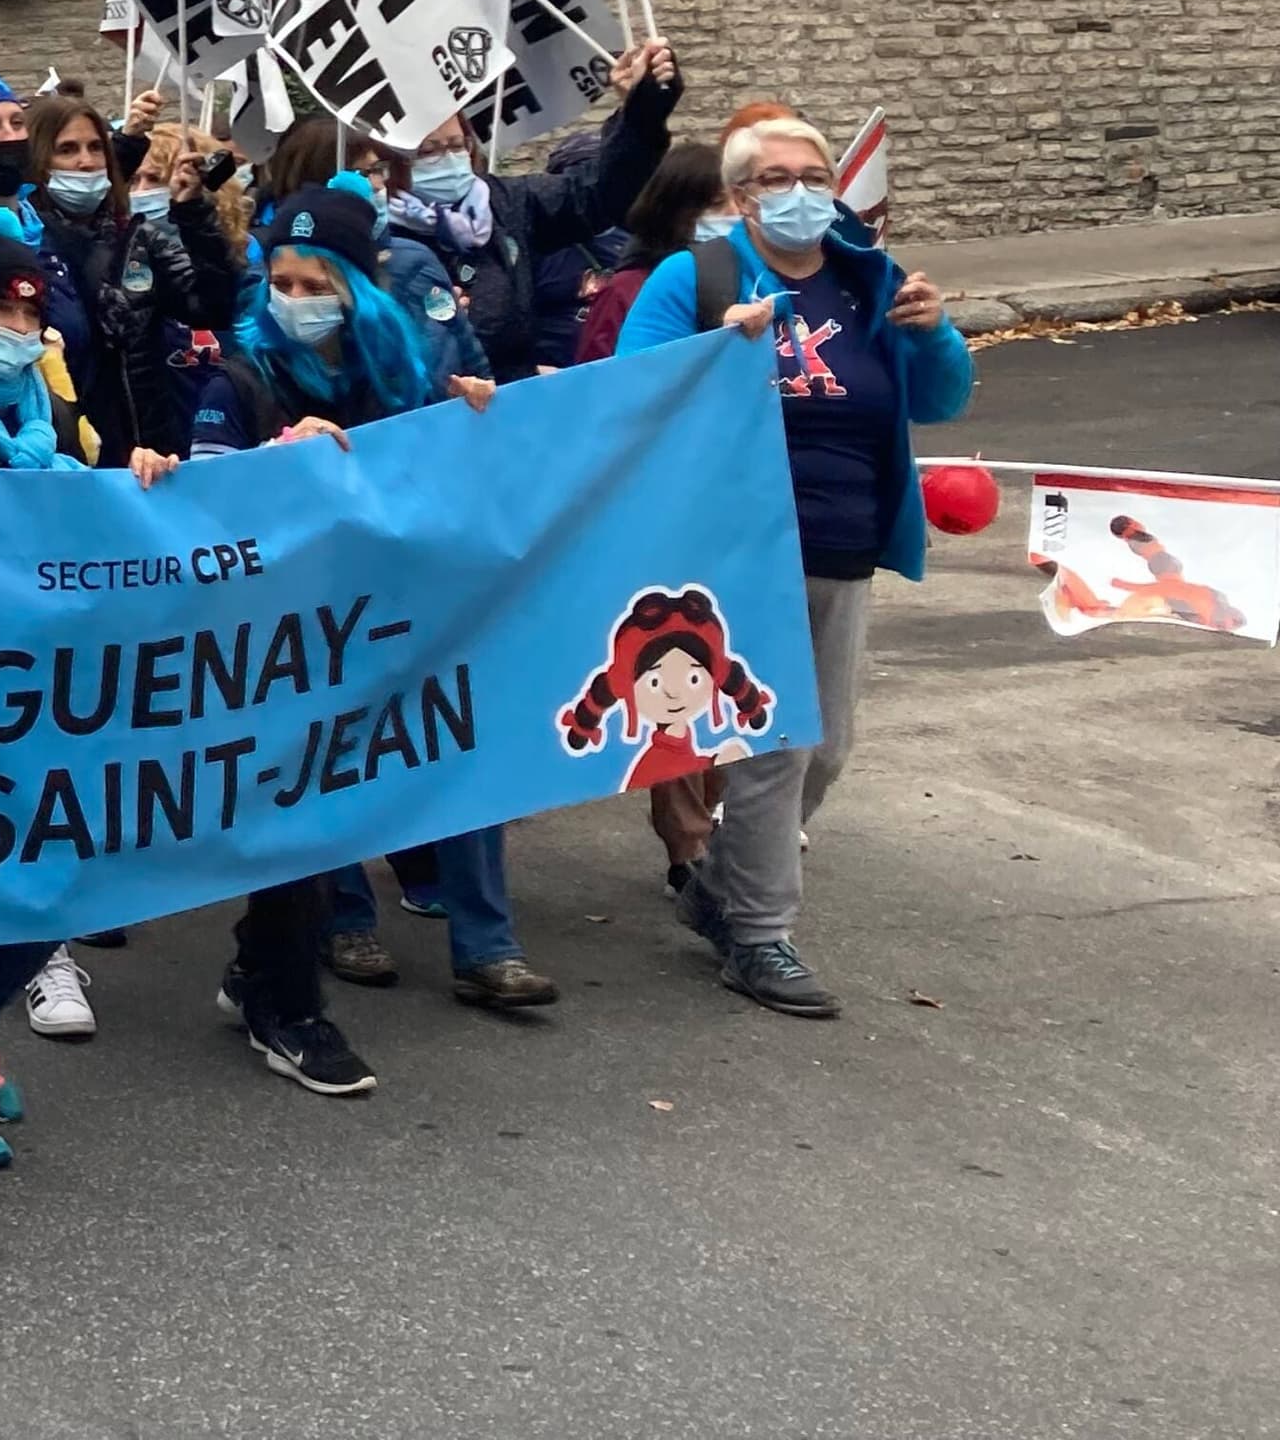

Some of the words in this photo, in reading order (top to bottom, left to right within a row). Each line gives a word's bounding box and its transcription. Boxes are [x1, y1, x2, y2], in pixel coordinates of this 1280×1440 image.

[432, 45, 470, 102] CSN
[570, 65, 605, 104] CSN
[38, 556, 182, 591] SECTEUR
[192, 538, 264, 586] CPE
